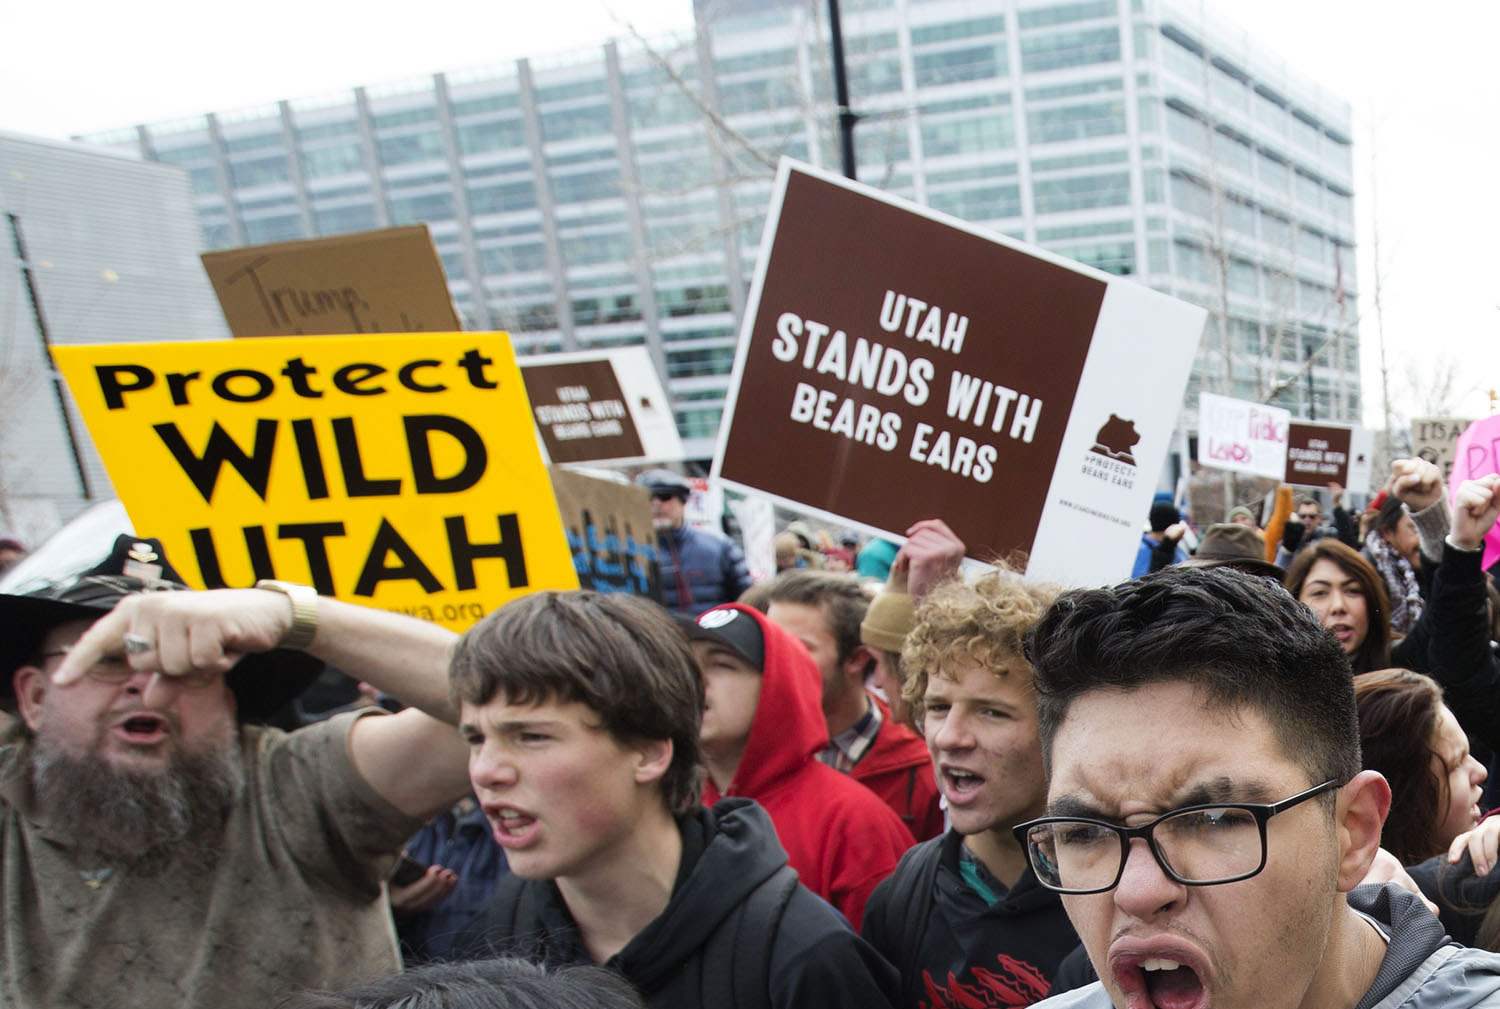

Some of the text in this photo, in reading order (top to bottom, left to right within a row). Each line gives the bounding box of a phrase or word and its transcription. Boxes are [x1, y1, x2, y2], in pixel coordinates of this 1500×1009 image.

[879, 289, 969, 354] UTAH
[94, 348, 500, 410] Protect
[772, 312, 1043, 443] STANDS WITH
[152, 414, 488, 505] WILD
[790, 382, 998, 483] BEARS EARS
[189, 513, 529, 598] UTAH
